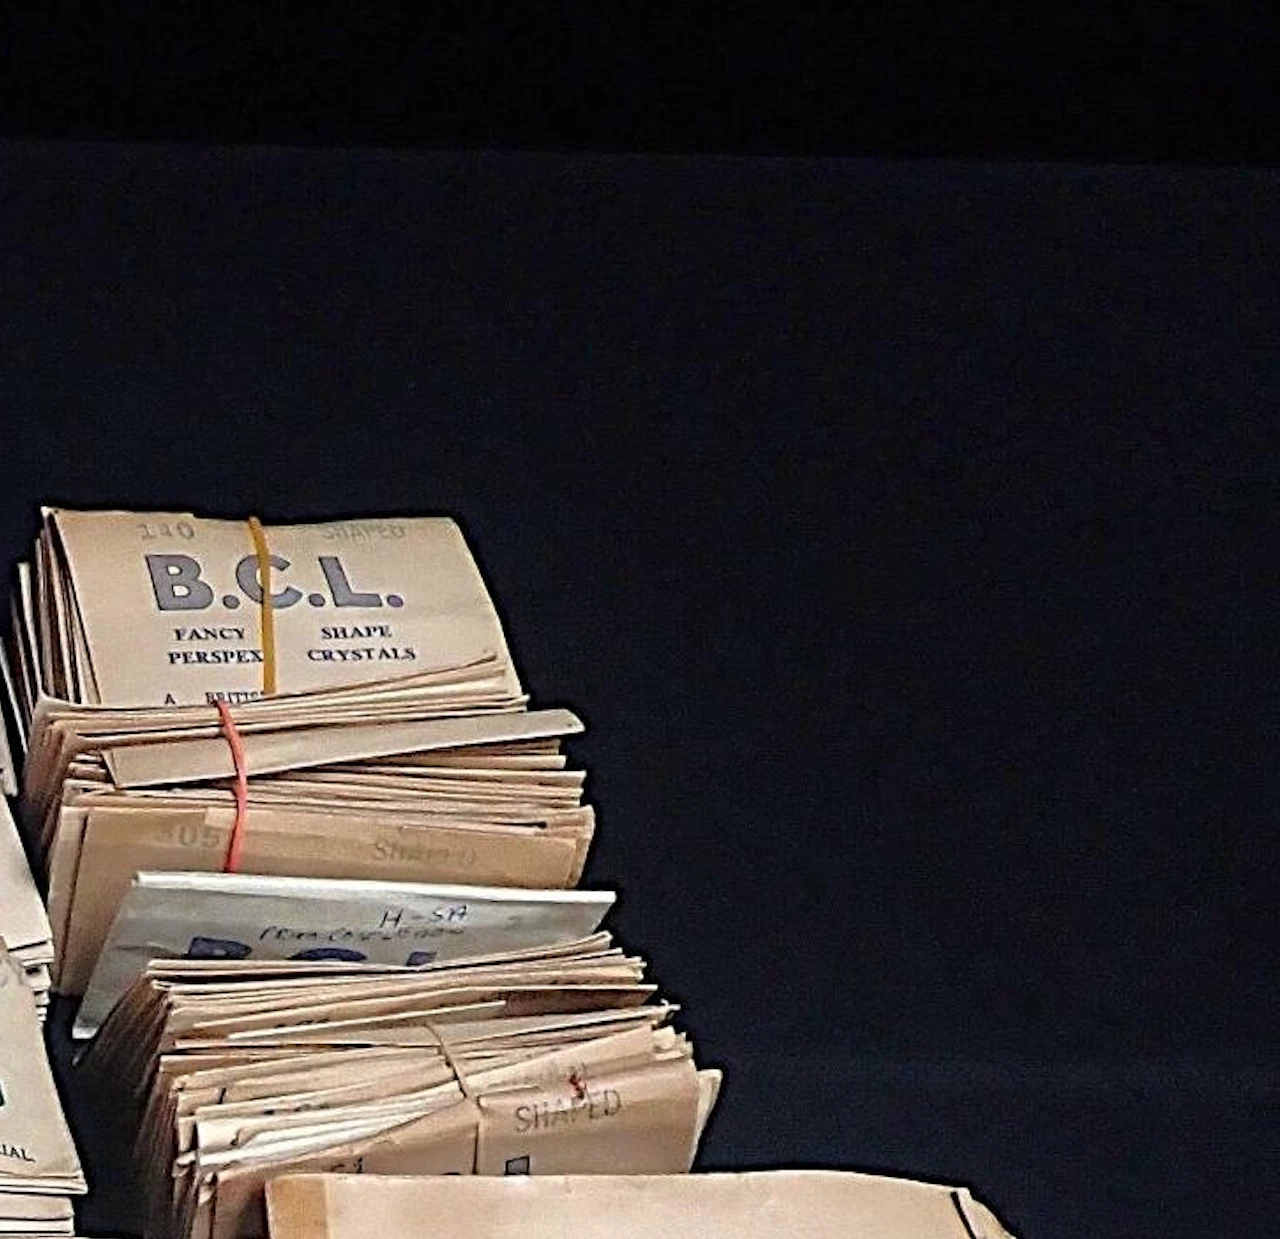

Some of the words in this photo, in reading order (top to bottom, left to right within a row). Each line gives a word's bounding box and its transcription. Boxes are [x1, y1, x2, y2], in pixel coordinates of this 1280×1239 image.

[145, 553, 405, 611] B.C.L.
[174, 626, 246, 642] FANCY
[320, 625, 393, 640] SHAPE
[167, 649, 266, 665] PERSPEX
[307, 646, 417, 663] CRYSTALS
